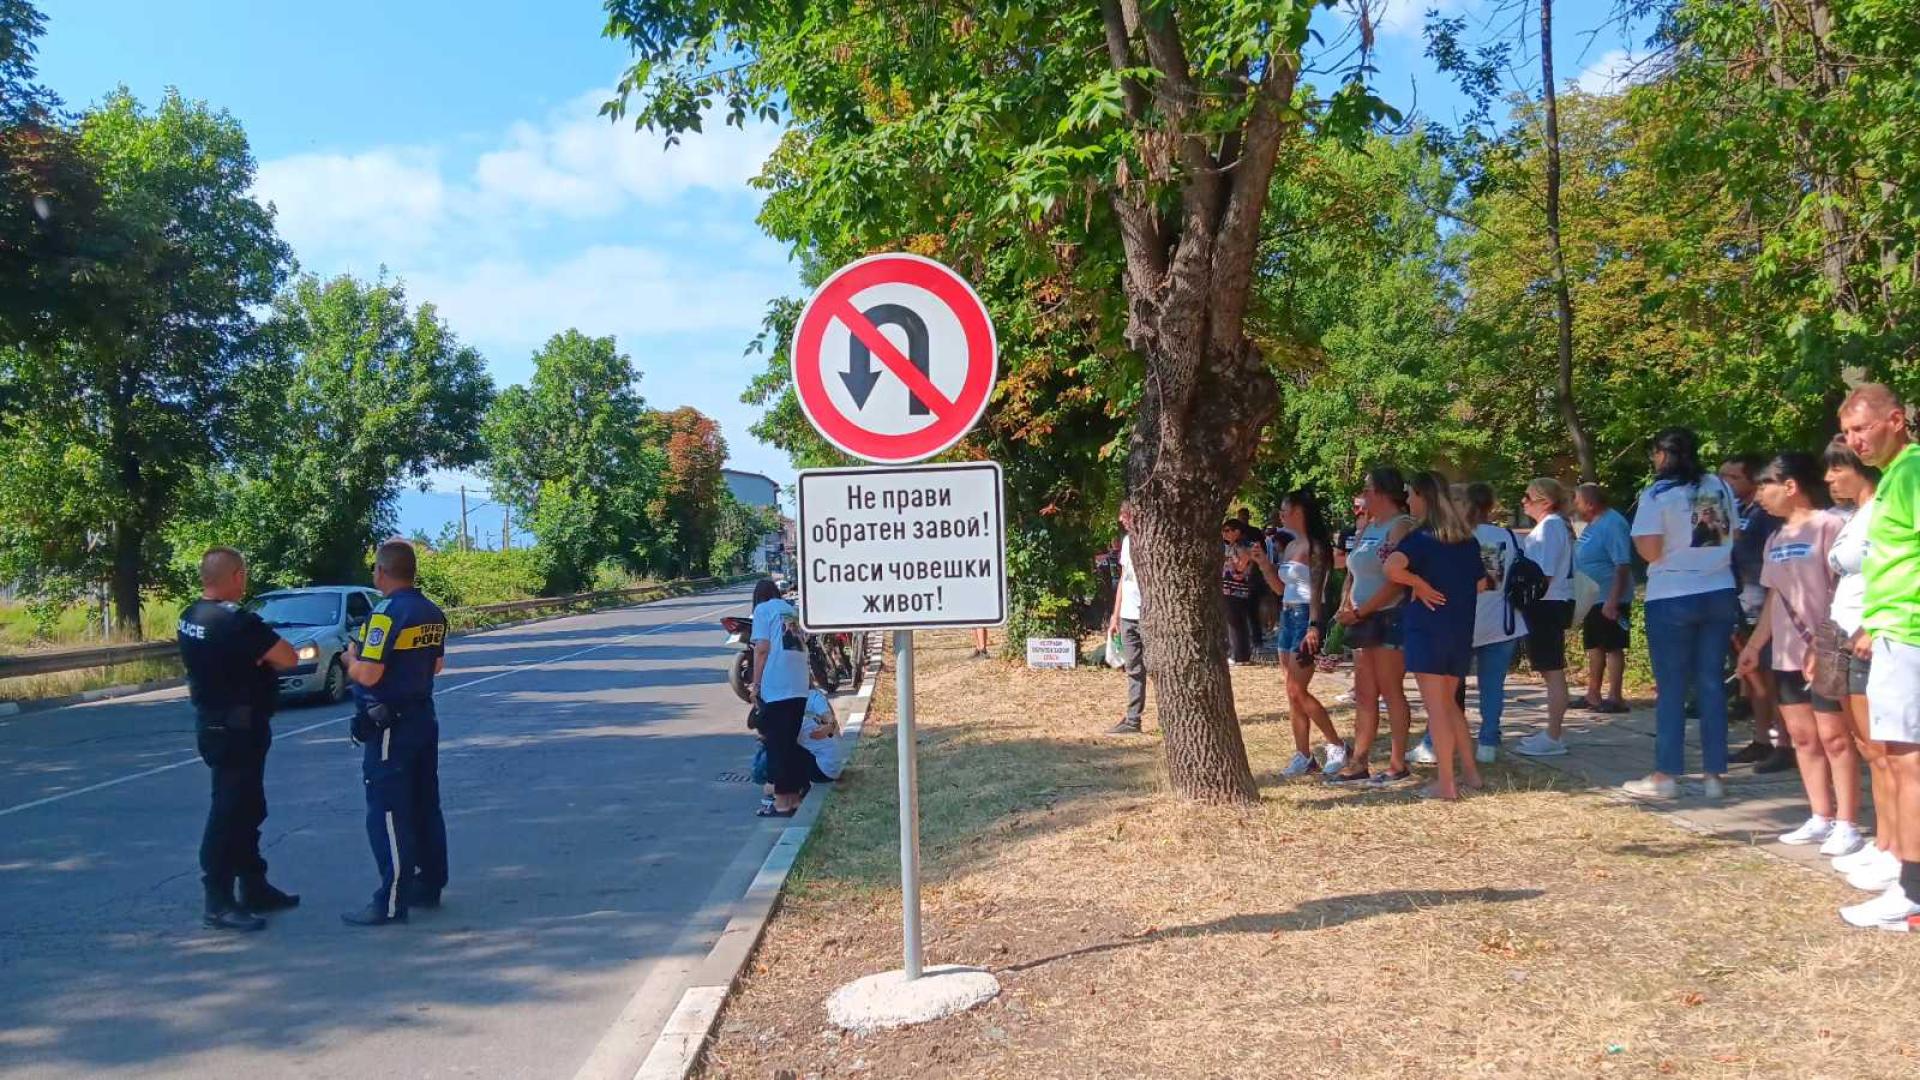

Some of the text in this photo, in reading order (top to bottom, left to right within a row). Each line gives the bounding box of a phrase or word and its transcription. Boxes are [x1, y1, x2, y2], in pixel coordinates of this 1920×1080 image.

[847, 485, 951, 515] Не прави
[812, 511, 990, 548] обратен завой!
[812, 558, 991, 583] Спаси човешки
[862, 586, 943, 613] живот!
